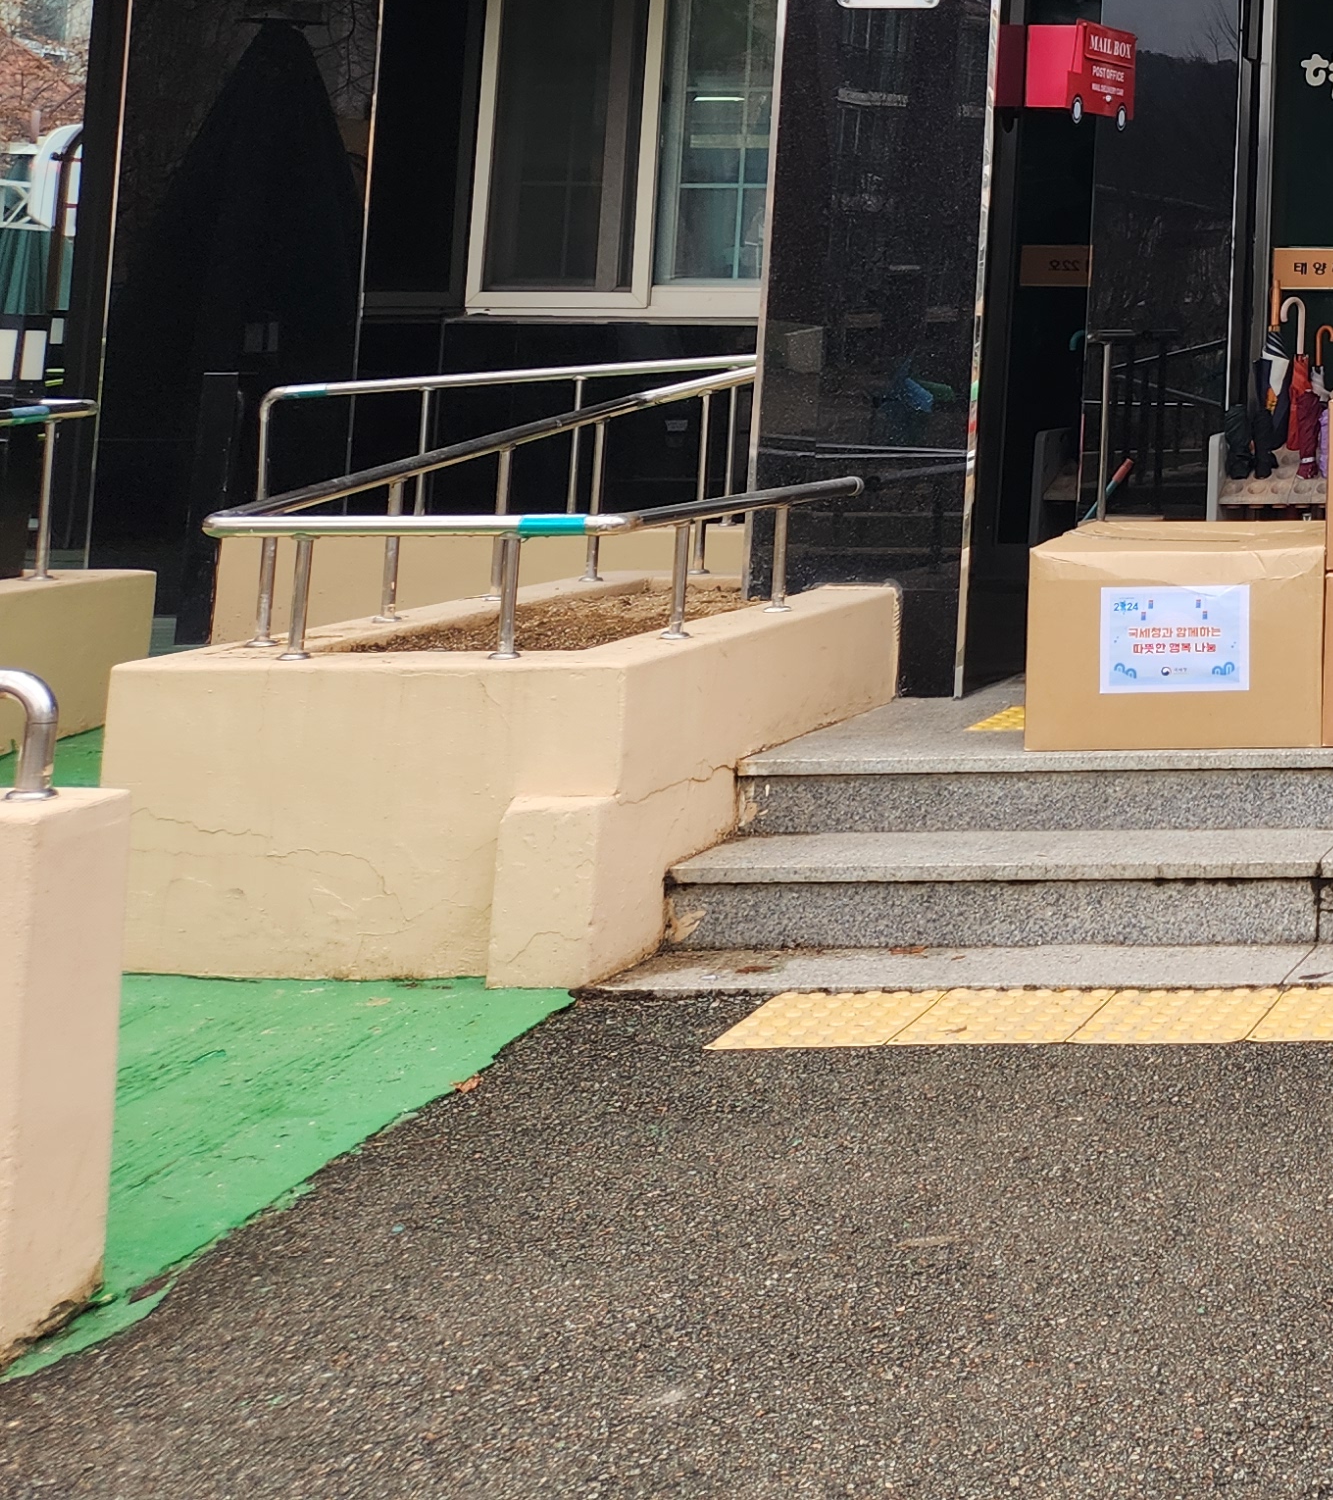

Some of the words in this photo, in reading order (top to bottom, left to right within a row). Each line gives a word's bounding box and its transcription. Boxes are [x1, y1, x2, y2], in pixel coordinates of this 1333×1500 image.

[1089, 34, 1112, 55] MAIL
[1113, 40, 1132, 59] BOX
[1092, 65, 1106, 79] POST
[1106, 68, 1124, 82] OFFICE
[1114, 601, 1138, 611] 224
[1128, 628, 1173, 638] 국세청과
[1176, 626, 1221, 637] 함께하는
[1133, 643, 1166, 653] 따뜻한
[1169, 643, 1191, 652] 행복
[1195, 643, 1216, 652] 나눔
